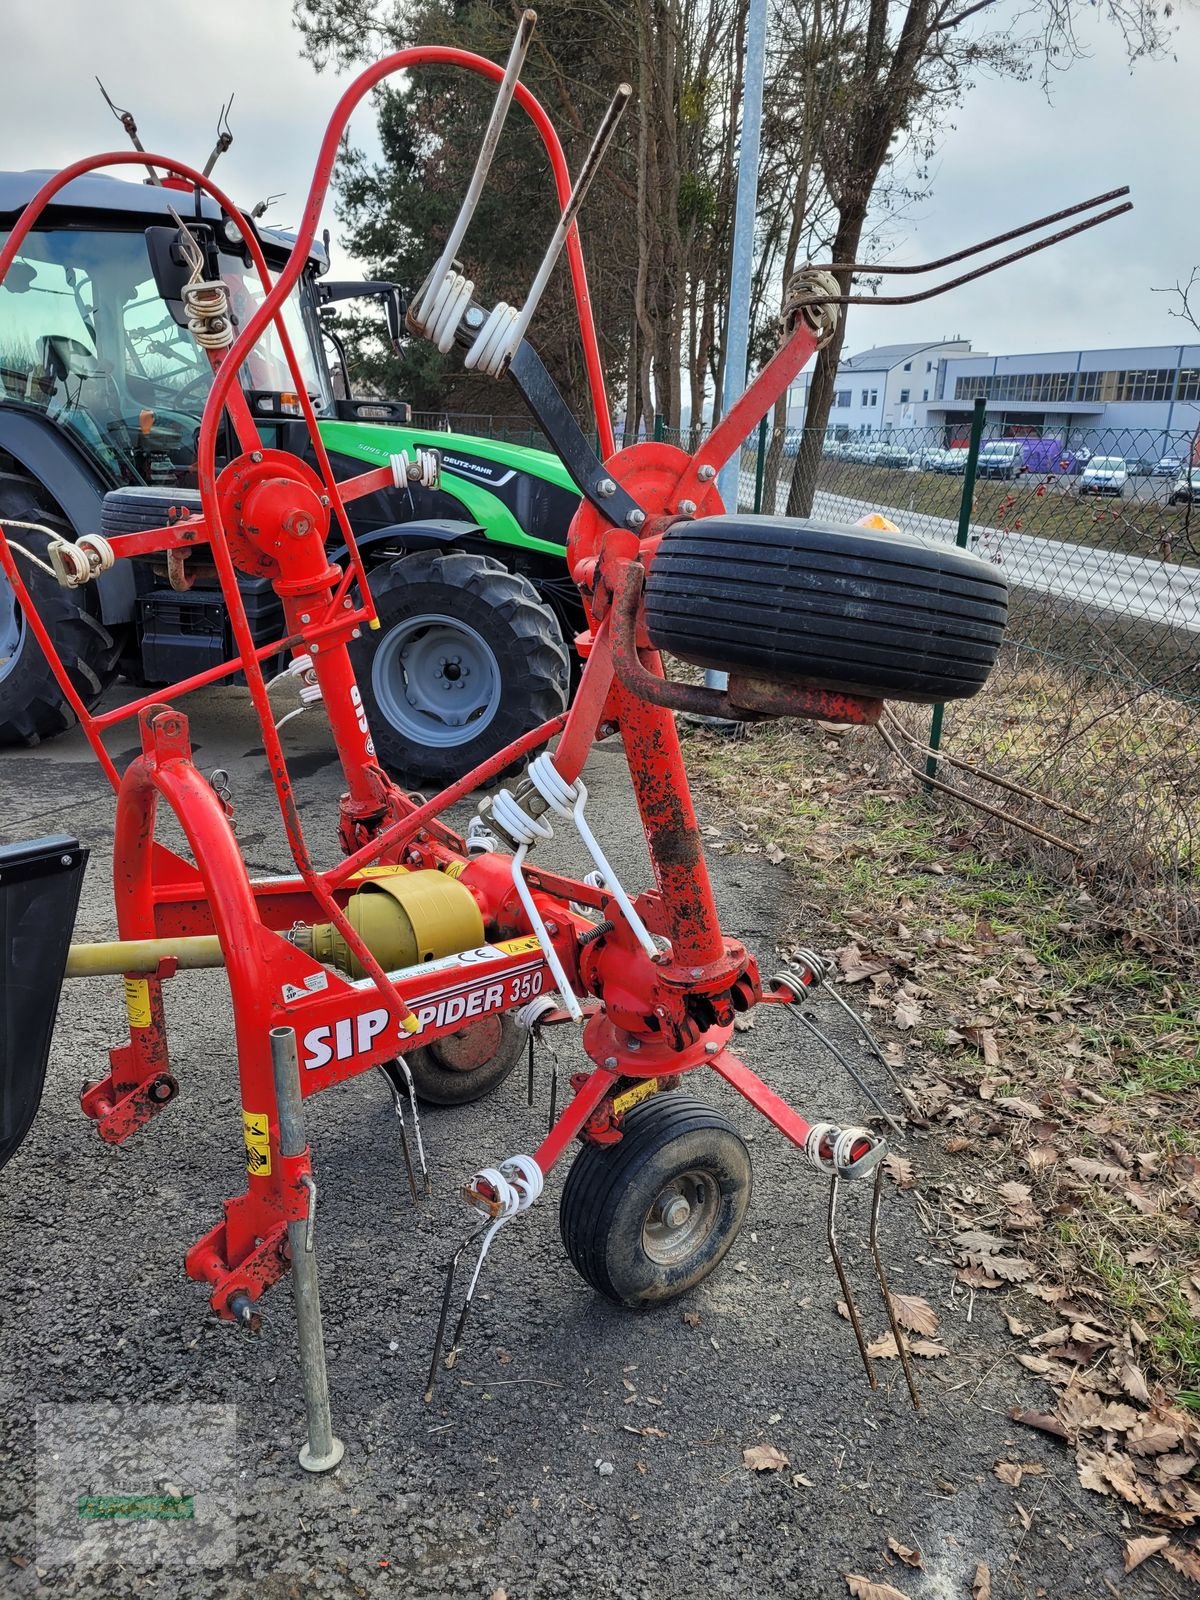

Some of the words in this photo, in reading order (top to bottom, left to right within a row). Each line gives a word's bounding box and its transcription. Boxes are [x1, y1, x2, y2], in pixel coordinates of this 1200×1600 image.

[358, 443, 381, 455] 5095
[443, 455, 493, 475] DEUTZ-FAHR
[303, 1008, 390, 1071] SIP
[509, 971, 543, 1003] 350
